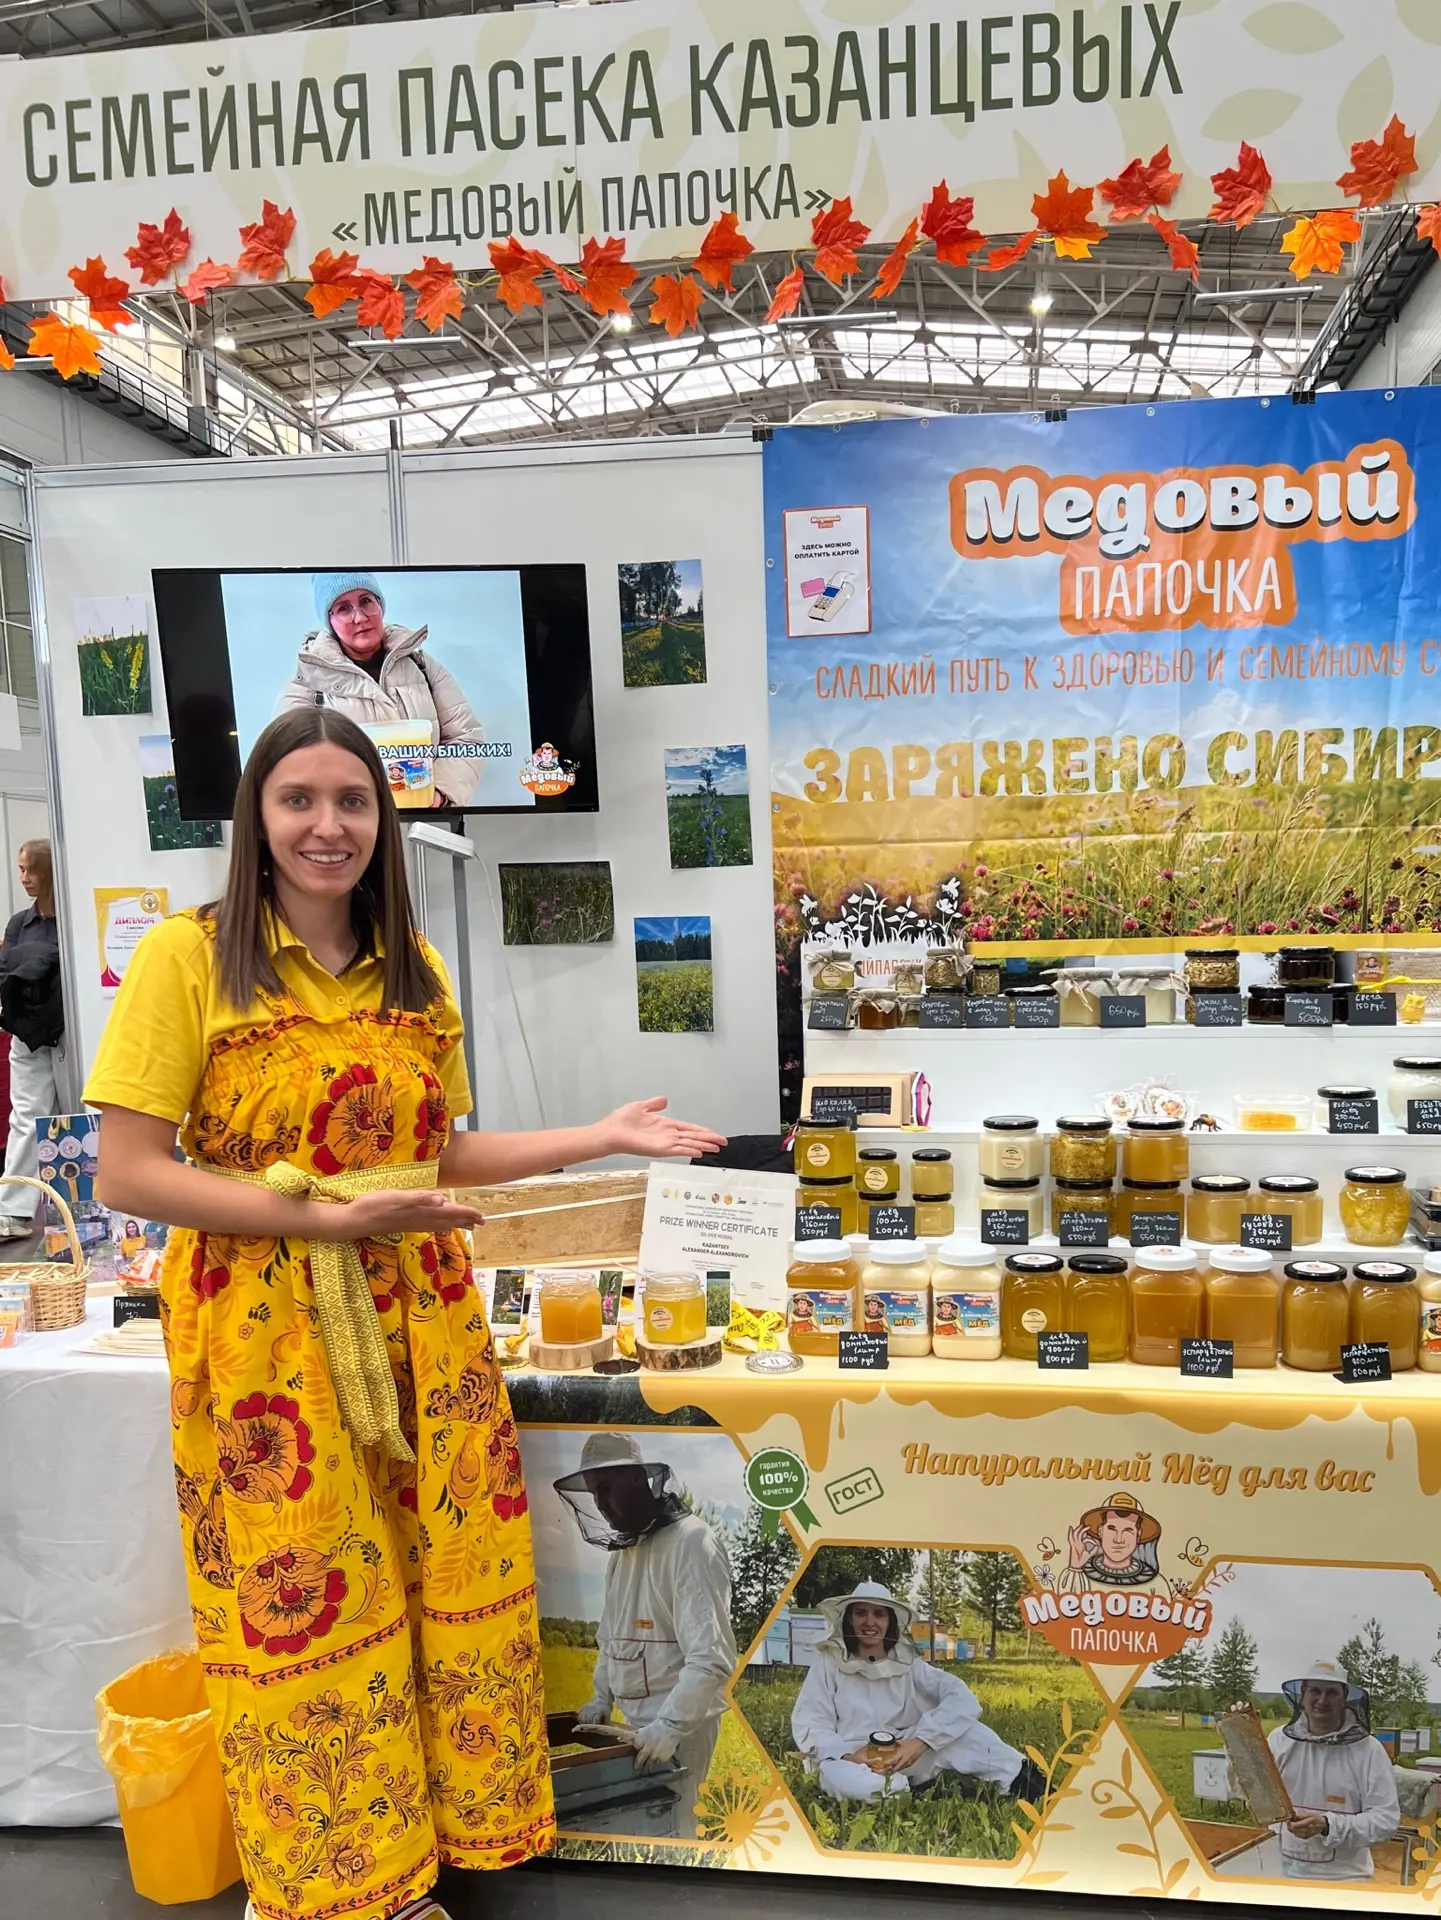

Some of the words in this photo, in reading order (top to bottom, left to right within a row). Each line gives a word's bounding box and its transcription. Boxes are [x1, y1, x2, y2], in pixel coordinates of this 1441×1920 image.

[24, 66, 371, 188] СЕМЕЙНАЯ
[399, 49, 664, 157] ПАСЕКА
[689, 0, 1183, 136] КАЗАНЦЕВЫХ
[332, 166, 583, 247] «МЕДОВЫЙ
[601, 163, 833, 233] ПАПОЧКА»
[964, 450, 1400, 560] Медовый
[795, 551, 830, 559] ОПЛАТИТЬ
[832, 549, 859, 557] КАРТОЙ
[825, 541, 851, 549] МОЖНО
[1074, 557, 1282, 620] ПАПОЧКА
[816, 653, 936, 700] СЛАДКИЙ
[950, 656, 1011, 694] ПУТЬ
[1024, 656, 1039, 690] К
[1052, 648, 1194, 691] ЗДОРОВЬЮ
[1208, 648, 1224, 682] И
[1240, 636, 1407, 680] СЕМЕЙНОМУ
[1420, 637, 1441, 675] С
[378, 744, 434, 759] ВАШИХ
[438, 743, 512, 758] БЛИЗКИХ!
[521, 771, 575, 786] Медовый
[803, 733, 1188, 803] ЗАРЯЖЕНО
[115, 916, 155, 925] ДИПЛОМ
[660, 1216, 684, 1228] PRIZE
[686, 1219, 719, 1231] WINNER
[721, 1223, 779, 1238] CERTIFICATE
[682, 1246, 710, 1255] ALEXANDER
[710, 1250, 749, 1259] ALEXANDROVICH
[702, 1242, 730, 1250] KAZANTSEV
[759, 1460, 790, 1471] гарантия
[900, 1442, 1152, 1486] Натуральный
[1161, 1452, 1232, 1496] Мёд
[1237, 1464, 1308, 1497] для
[1314, 1460, 1376, 1493] вас
[759, 1471, 799, 1485] 100%
[762, 1486, 793, 1496] качества
[832, 1477, 873, 1505] ГОСТ
[1023, 1593, 1208, 1632] Медовый
[1070, 1628, 1159, 1654] ПАПОЧКА
